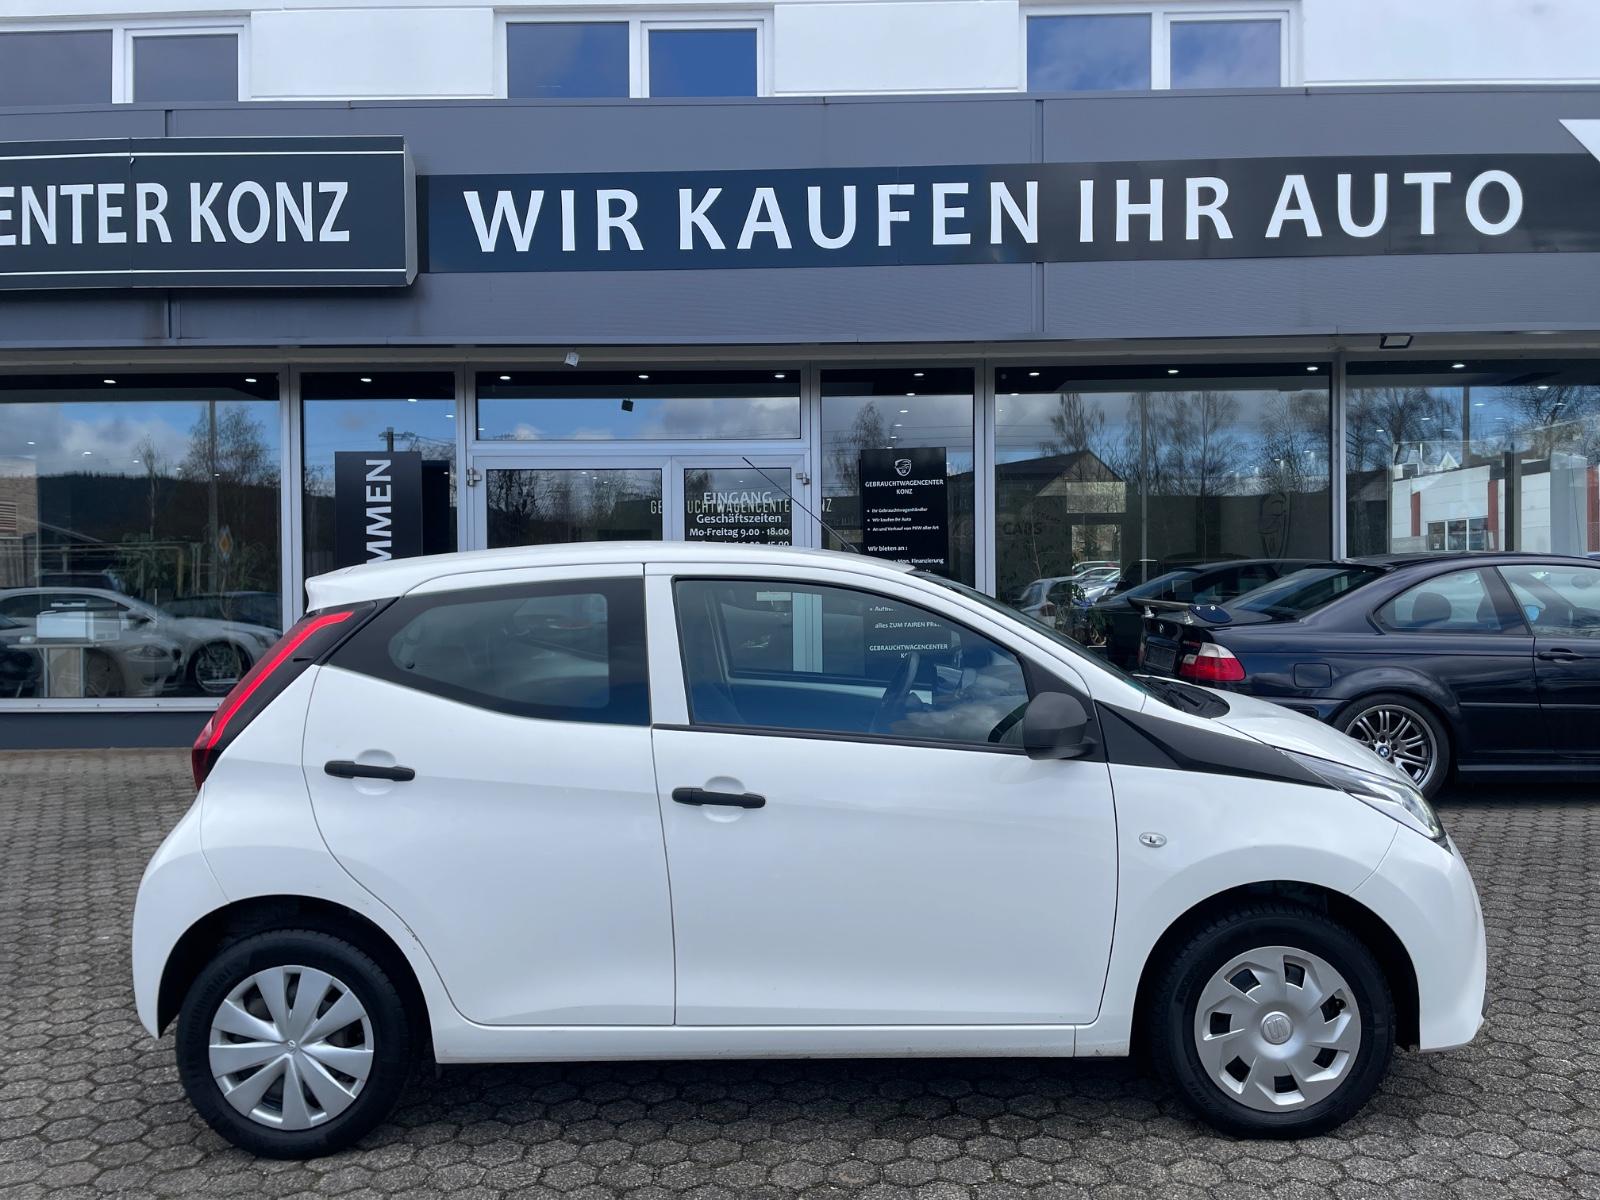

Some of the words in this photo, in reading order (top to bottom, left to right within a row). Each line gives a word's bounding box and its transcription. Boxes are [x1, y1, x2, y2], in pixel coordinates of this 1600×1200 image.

[190, 180, 350, 244] KONZ
[463, 189, 644, 253] WIR
[678, 181, 1038, 250] KAUFEN
[1079, 177, 1234, 243] IHR
[1265, 169, 1523, 238] AUTO
[864, 479, 944, 488] GEBRAUCHTWAGENCENTER
[703, 491, 772, 504] EINGANG
[696, 512, 782, 524] Geschäftszeiten
[689, 528, 739, 538] Mo-Freitag
[740, 529, 760, 538] 9.00
[766, 527, 790, 536] 18.00
[869, 643, 948, 651] GEBRAUCHTWAGENCENTER
